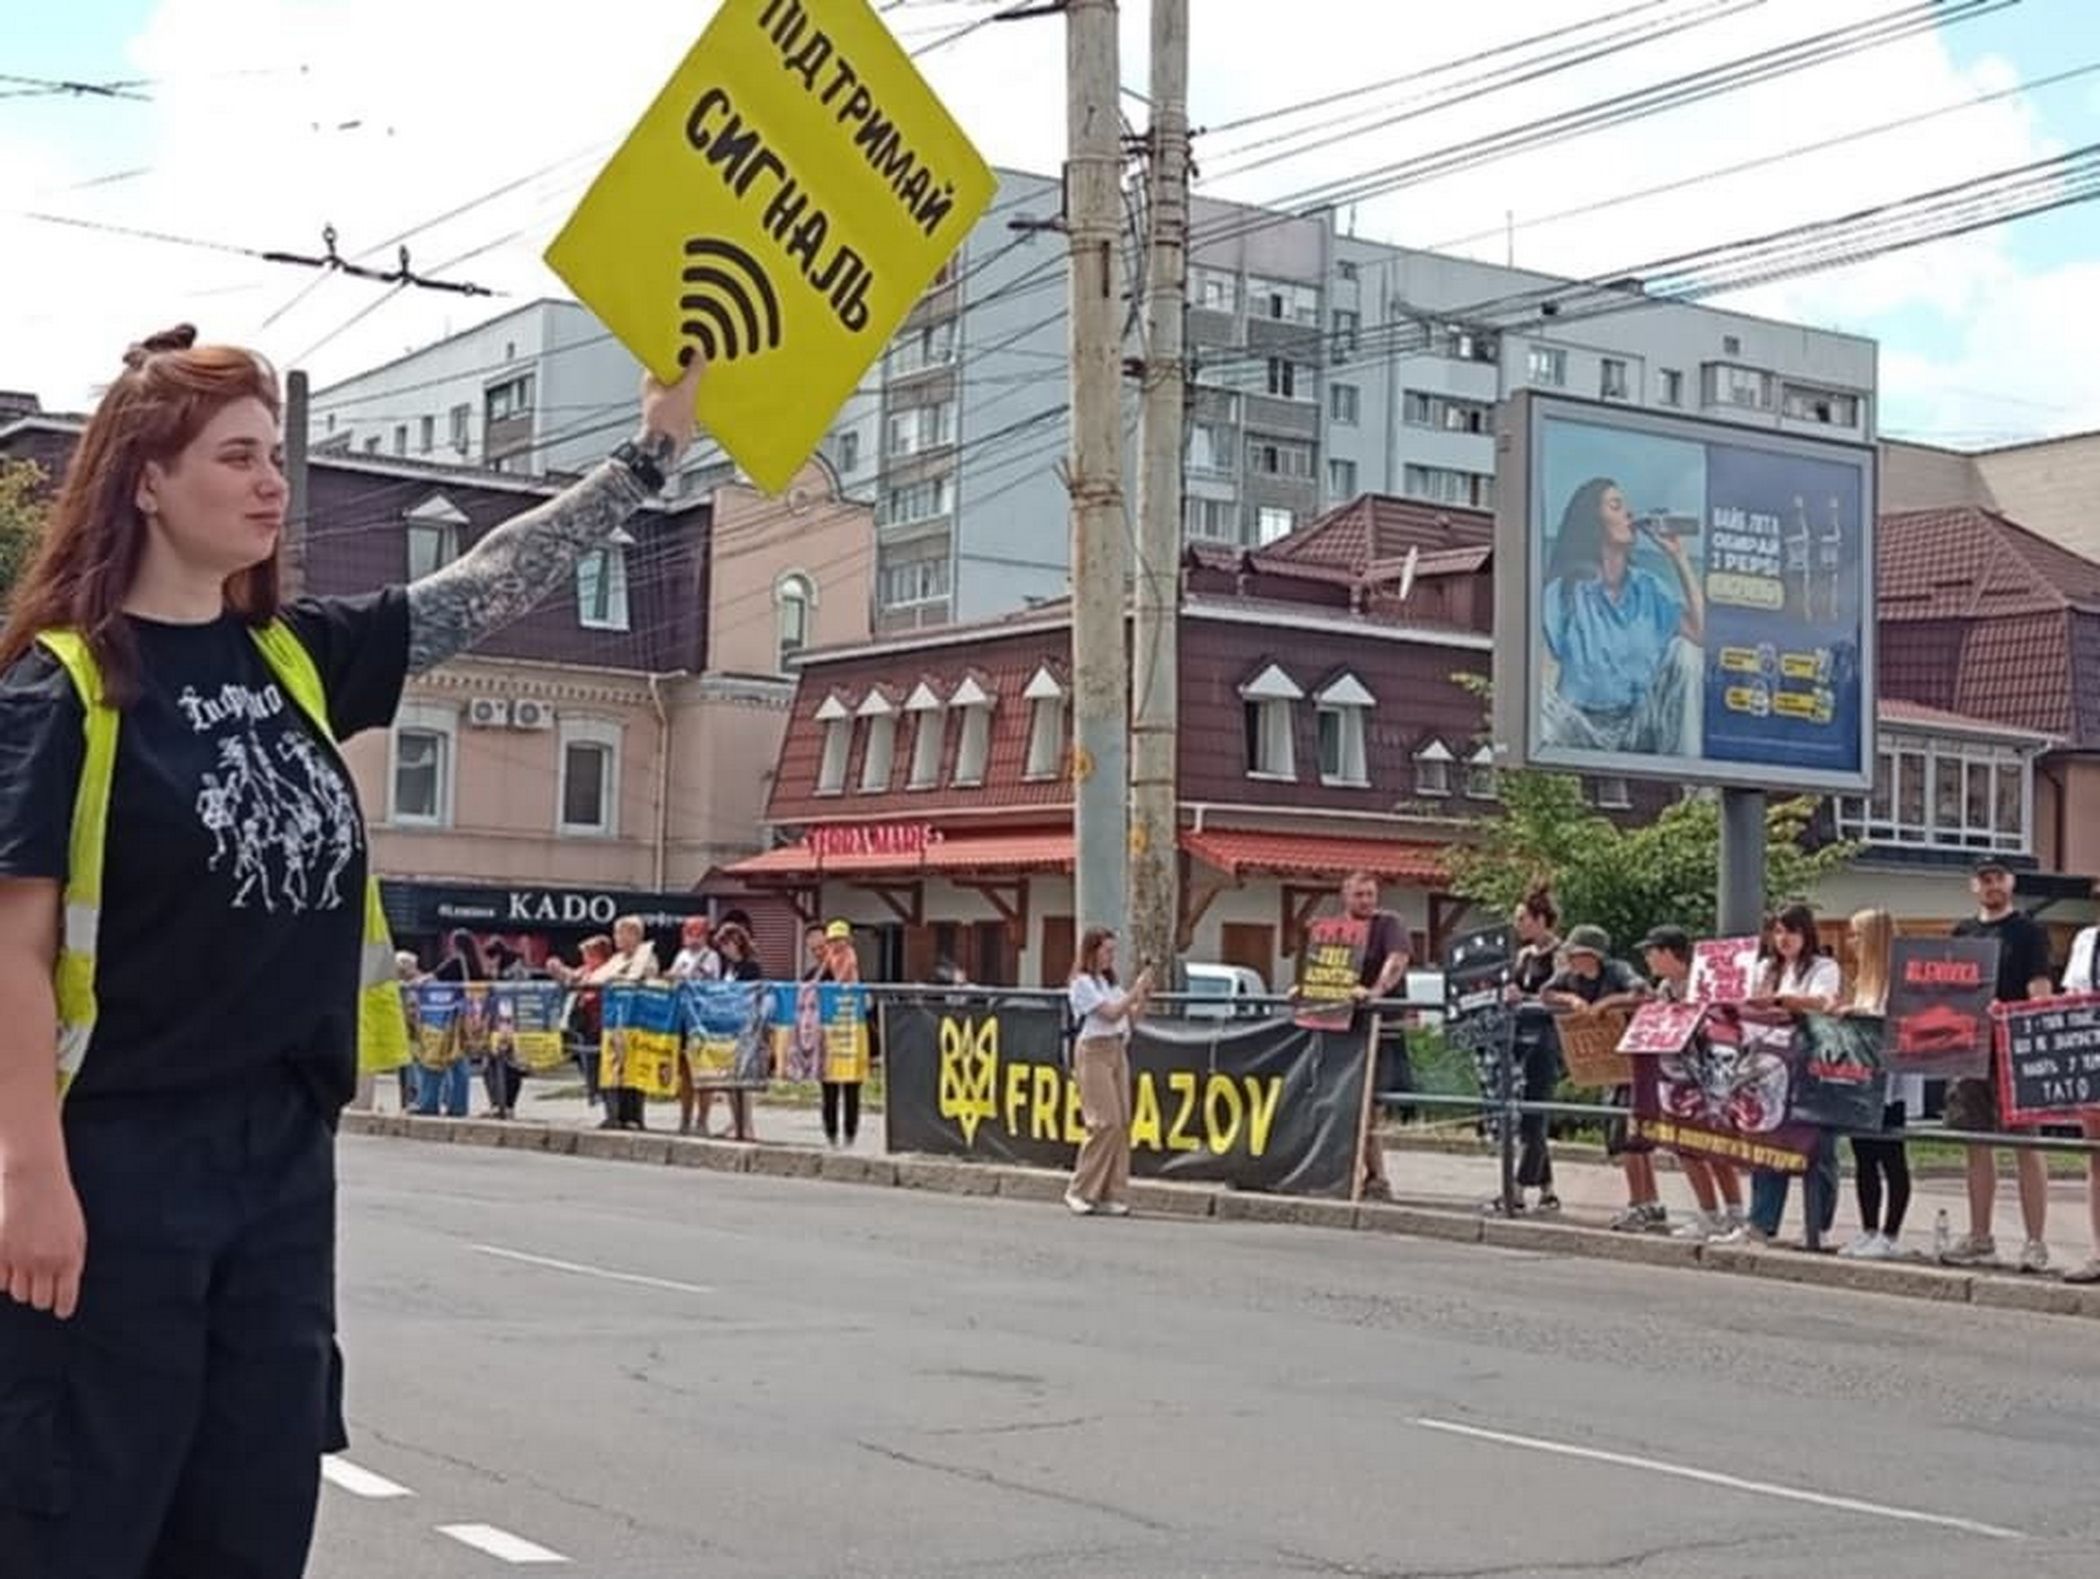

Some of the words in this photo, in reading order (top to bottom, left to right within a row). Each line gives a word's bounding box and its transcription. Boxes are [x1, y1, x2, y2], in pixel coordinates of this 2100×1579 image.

[758, 0, 954, 237] ПІДТРИМАЙ
[686, 87, 873, 333] СИГНАЛЬ
[507, 891, 617, 924] KADO
[1006, 1063, 1087, 1145] FRE
[1129, 1072, 1284, 1157] AZOV
